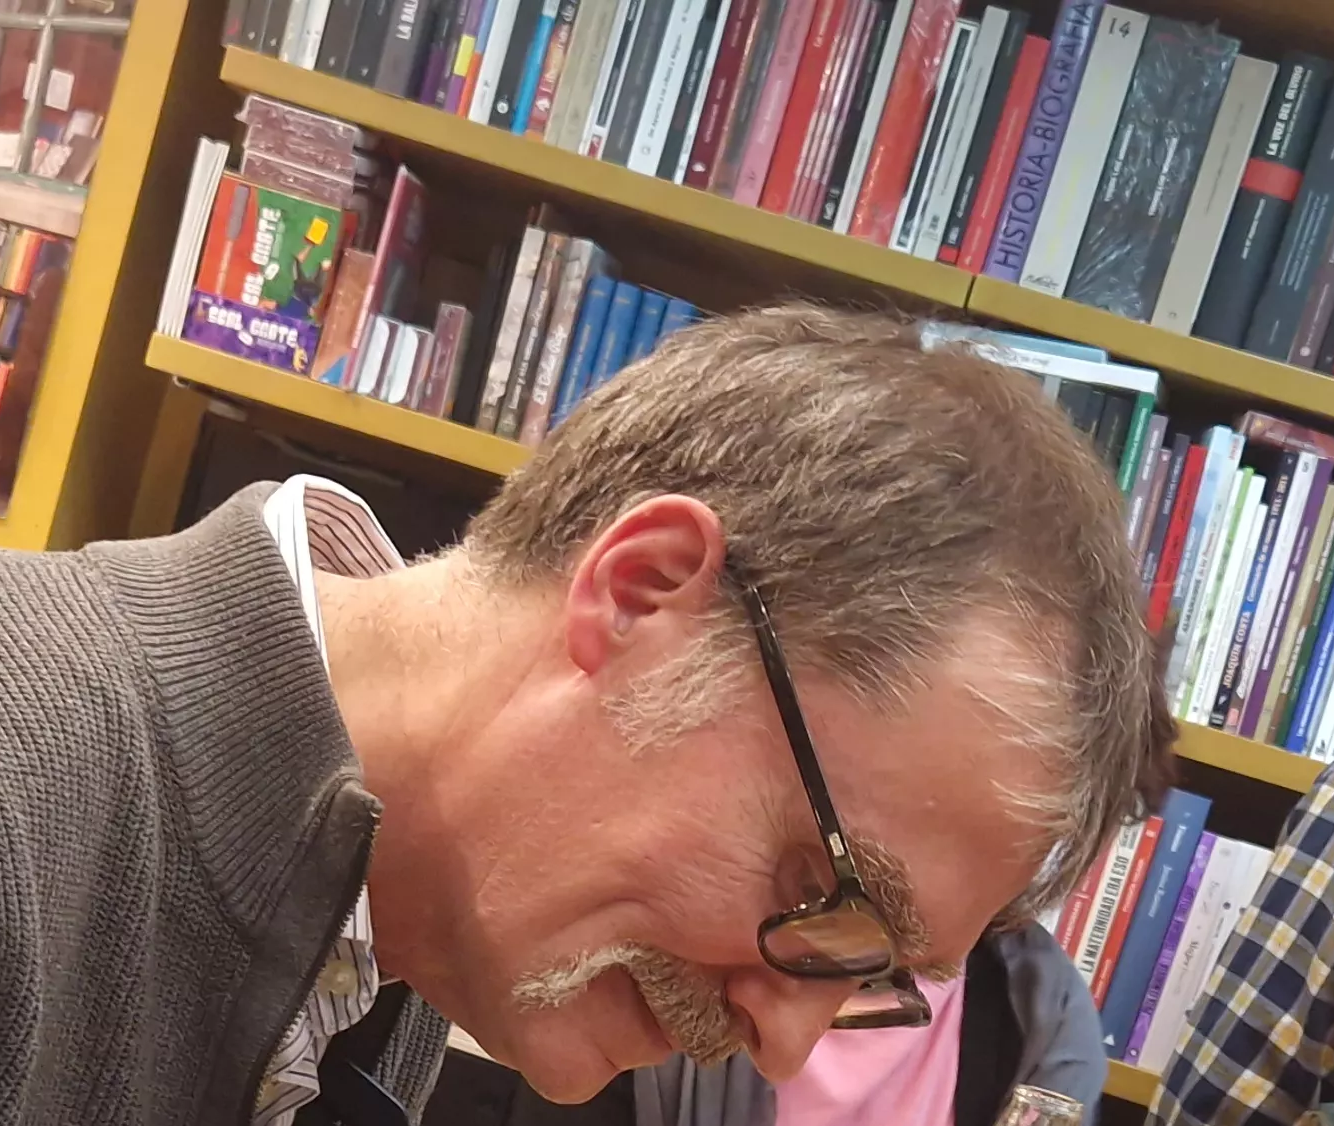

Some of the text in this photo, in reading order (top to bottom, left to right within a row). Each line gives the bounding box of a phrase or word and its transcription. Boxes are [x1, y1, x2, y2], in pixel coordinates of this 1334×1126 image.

[1233, 609, 1253, 643] COSTA
[1078, 853, 1129, 973] LA MATERNIDAD ERA ESO
